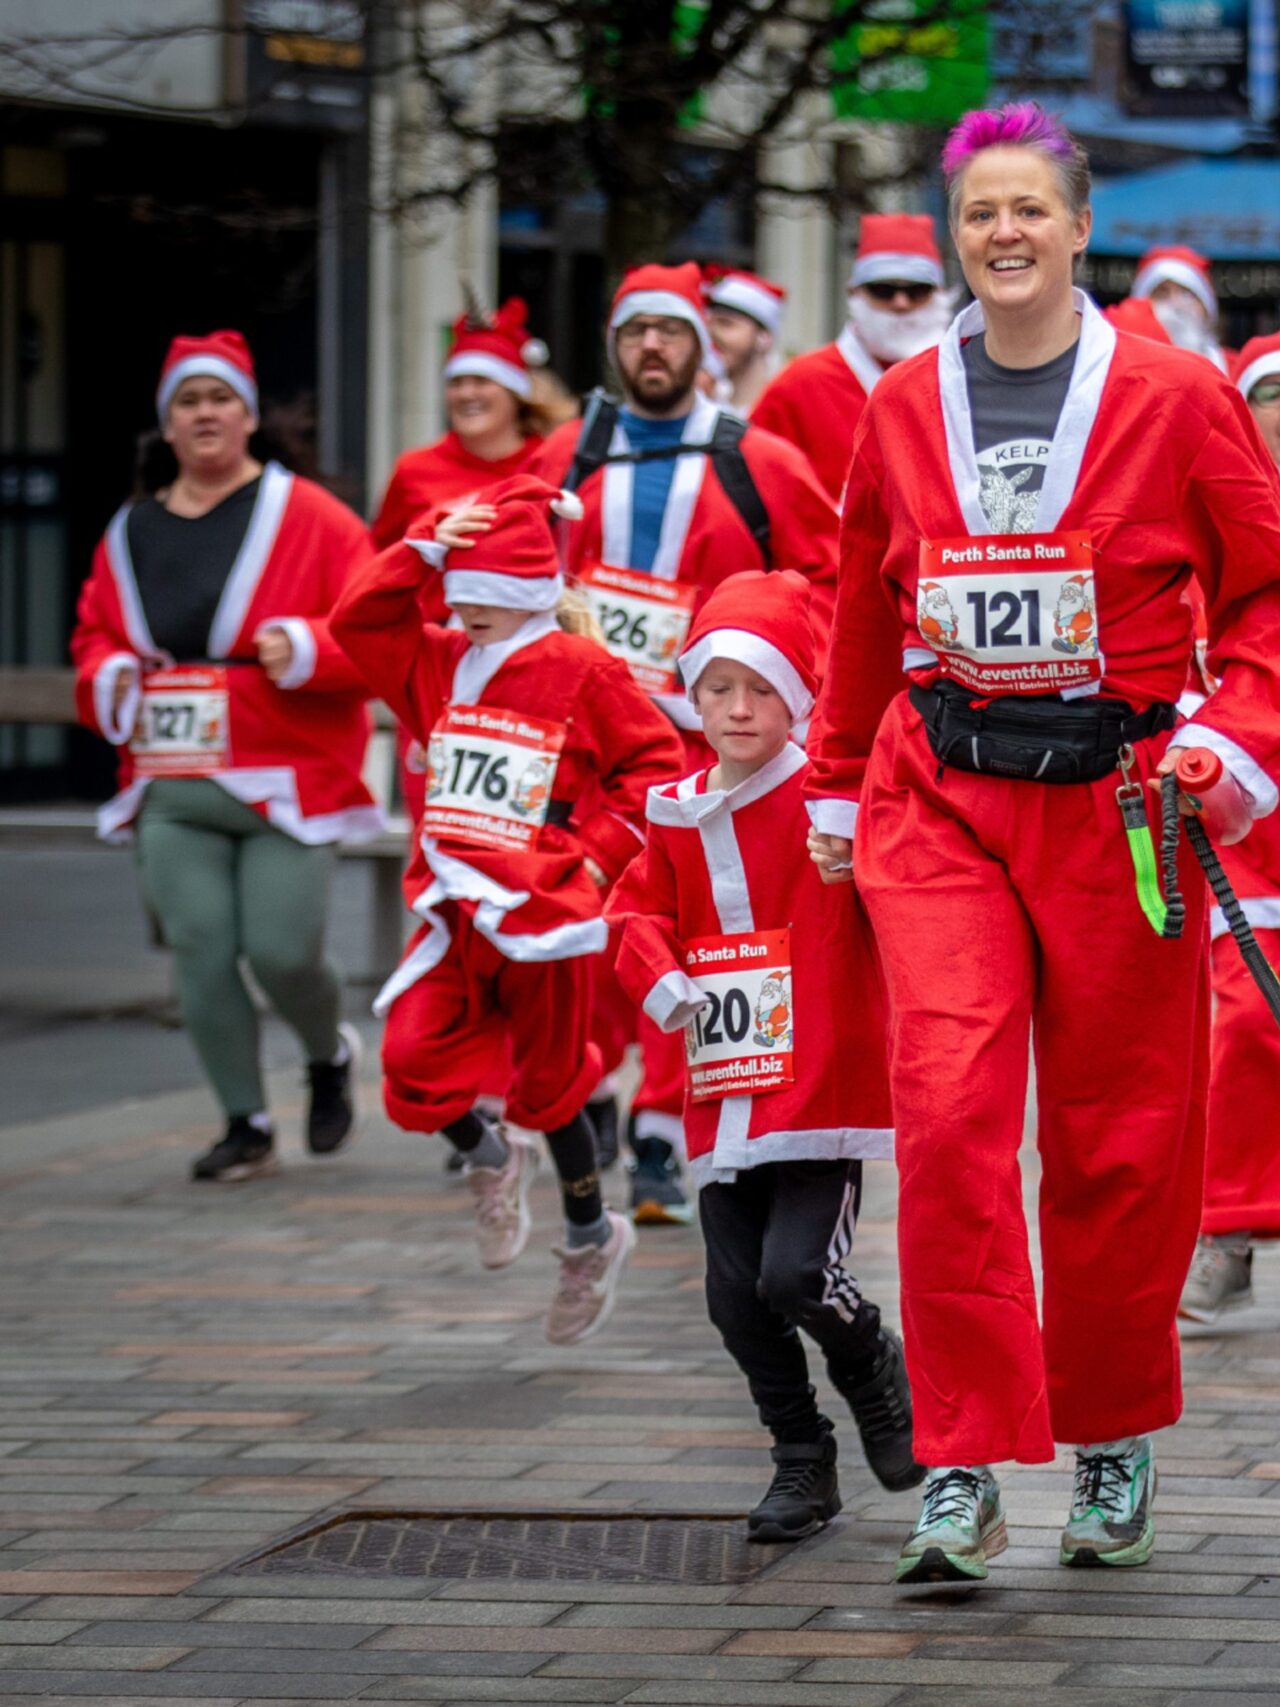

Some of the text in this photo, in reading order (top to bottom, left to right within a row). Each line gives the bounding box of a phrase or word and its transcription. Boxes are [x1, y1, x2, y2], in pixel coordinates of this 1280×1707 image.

[942, 544, 1066, 564] Perth Santa Run
[966, 589, 1041, 649] 121
[946, 655, 1090, 681] www.eventfull.biz
[1019, 681, 1050, 690] Entries
[151, 704, 197, 740] 127
[516, 723, 546, 740] Run
[449, 747, 509, 802] 176
[697, 947, 737, 963] Santa
[739, 943, 768, 958] Run
[694, 988, 751, 1048] 120
